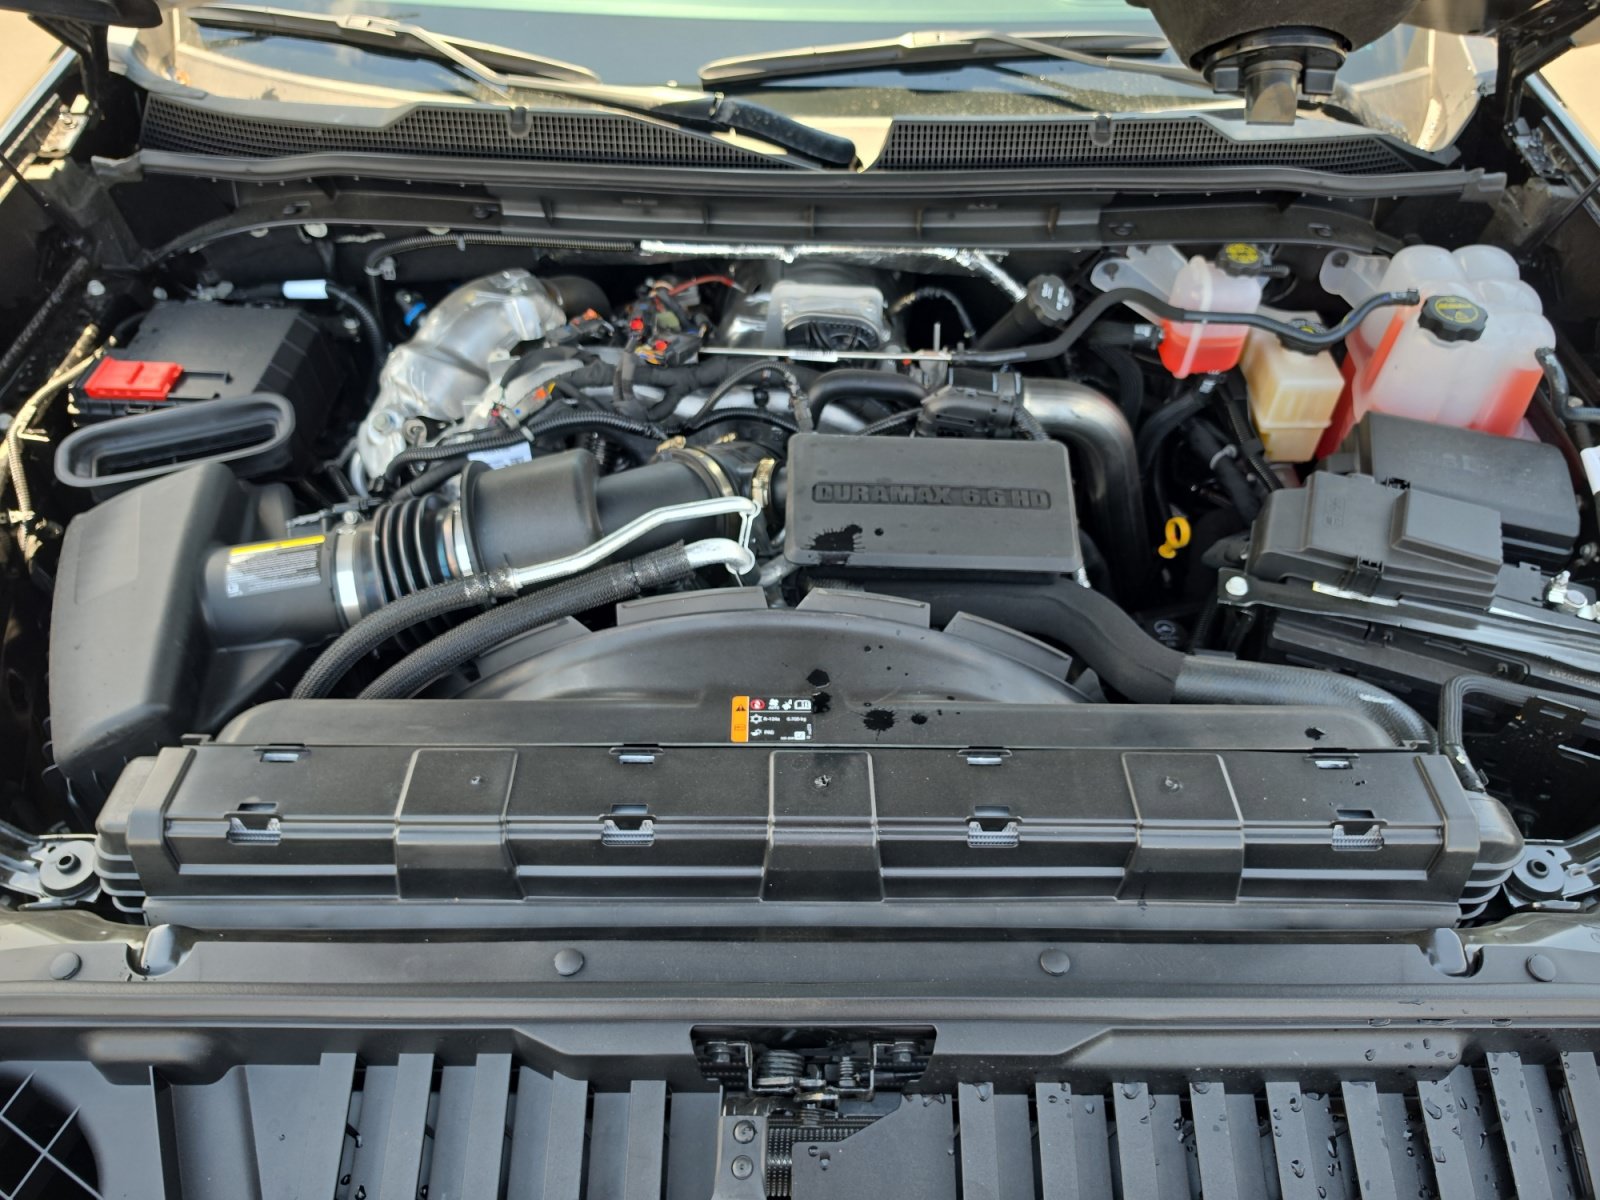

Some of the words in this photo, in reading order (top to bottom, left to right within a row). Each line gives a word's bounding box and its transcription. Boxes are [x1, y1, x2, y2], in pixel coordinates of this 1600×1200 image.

[814, 484, 951, 503] DURAMAX
[961, 487, 1007, 506] 6.6
[1011, 489, 1049, 508] HD
